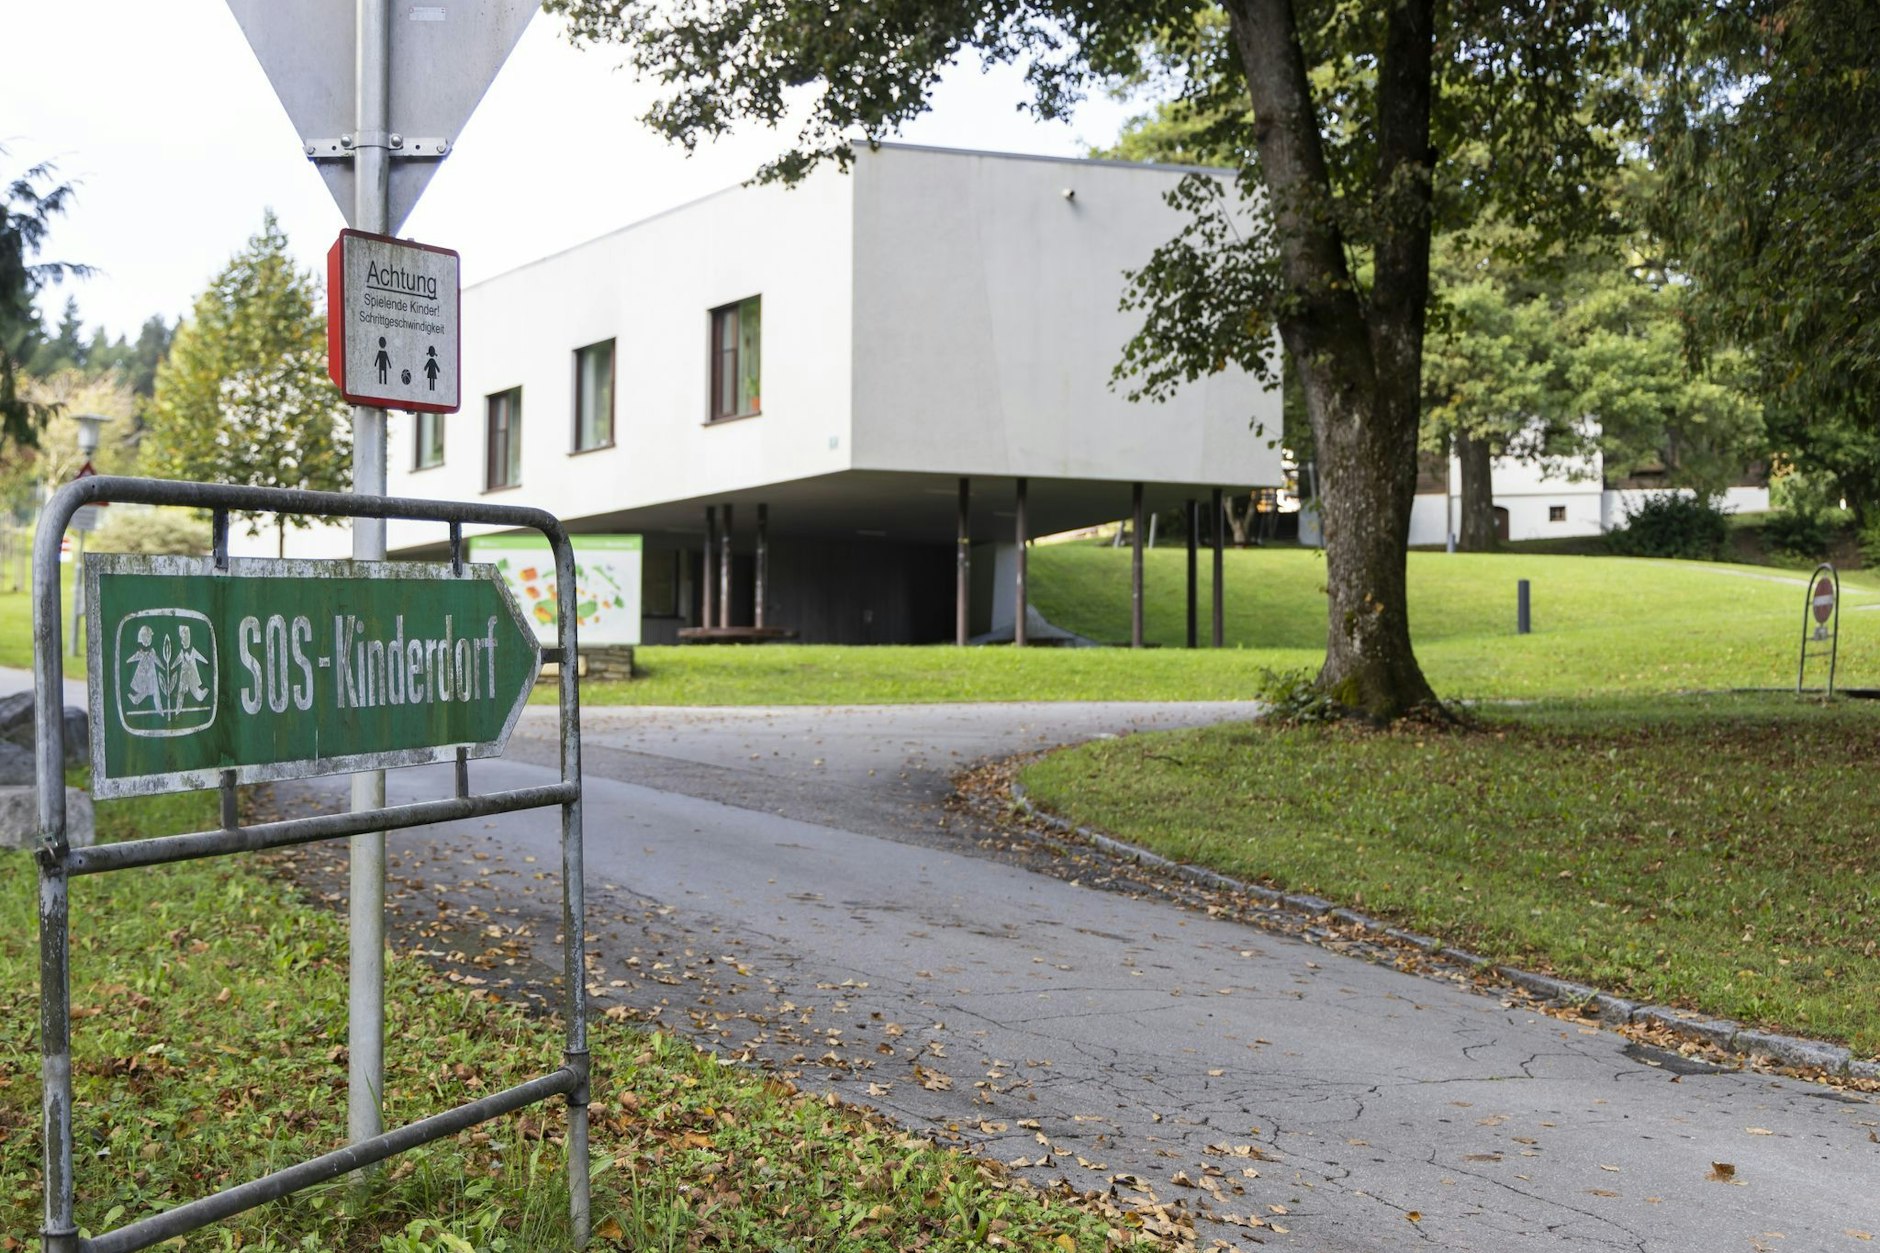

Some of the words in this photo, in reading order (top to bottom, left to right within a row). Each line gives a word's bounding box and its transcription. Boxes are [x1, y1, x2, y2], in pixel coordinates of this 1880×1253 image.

[366, 260, 437, 300] Achtung
[364, 293, 408, 311] Spielende
[410, 301, 440, 317] Kinder!
[360, 310, 445, 335] Schrittgeschwindigkeit
[238, 614, 498, 716] SOS-Kinderdorf
